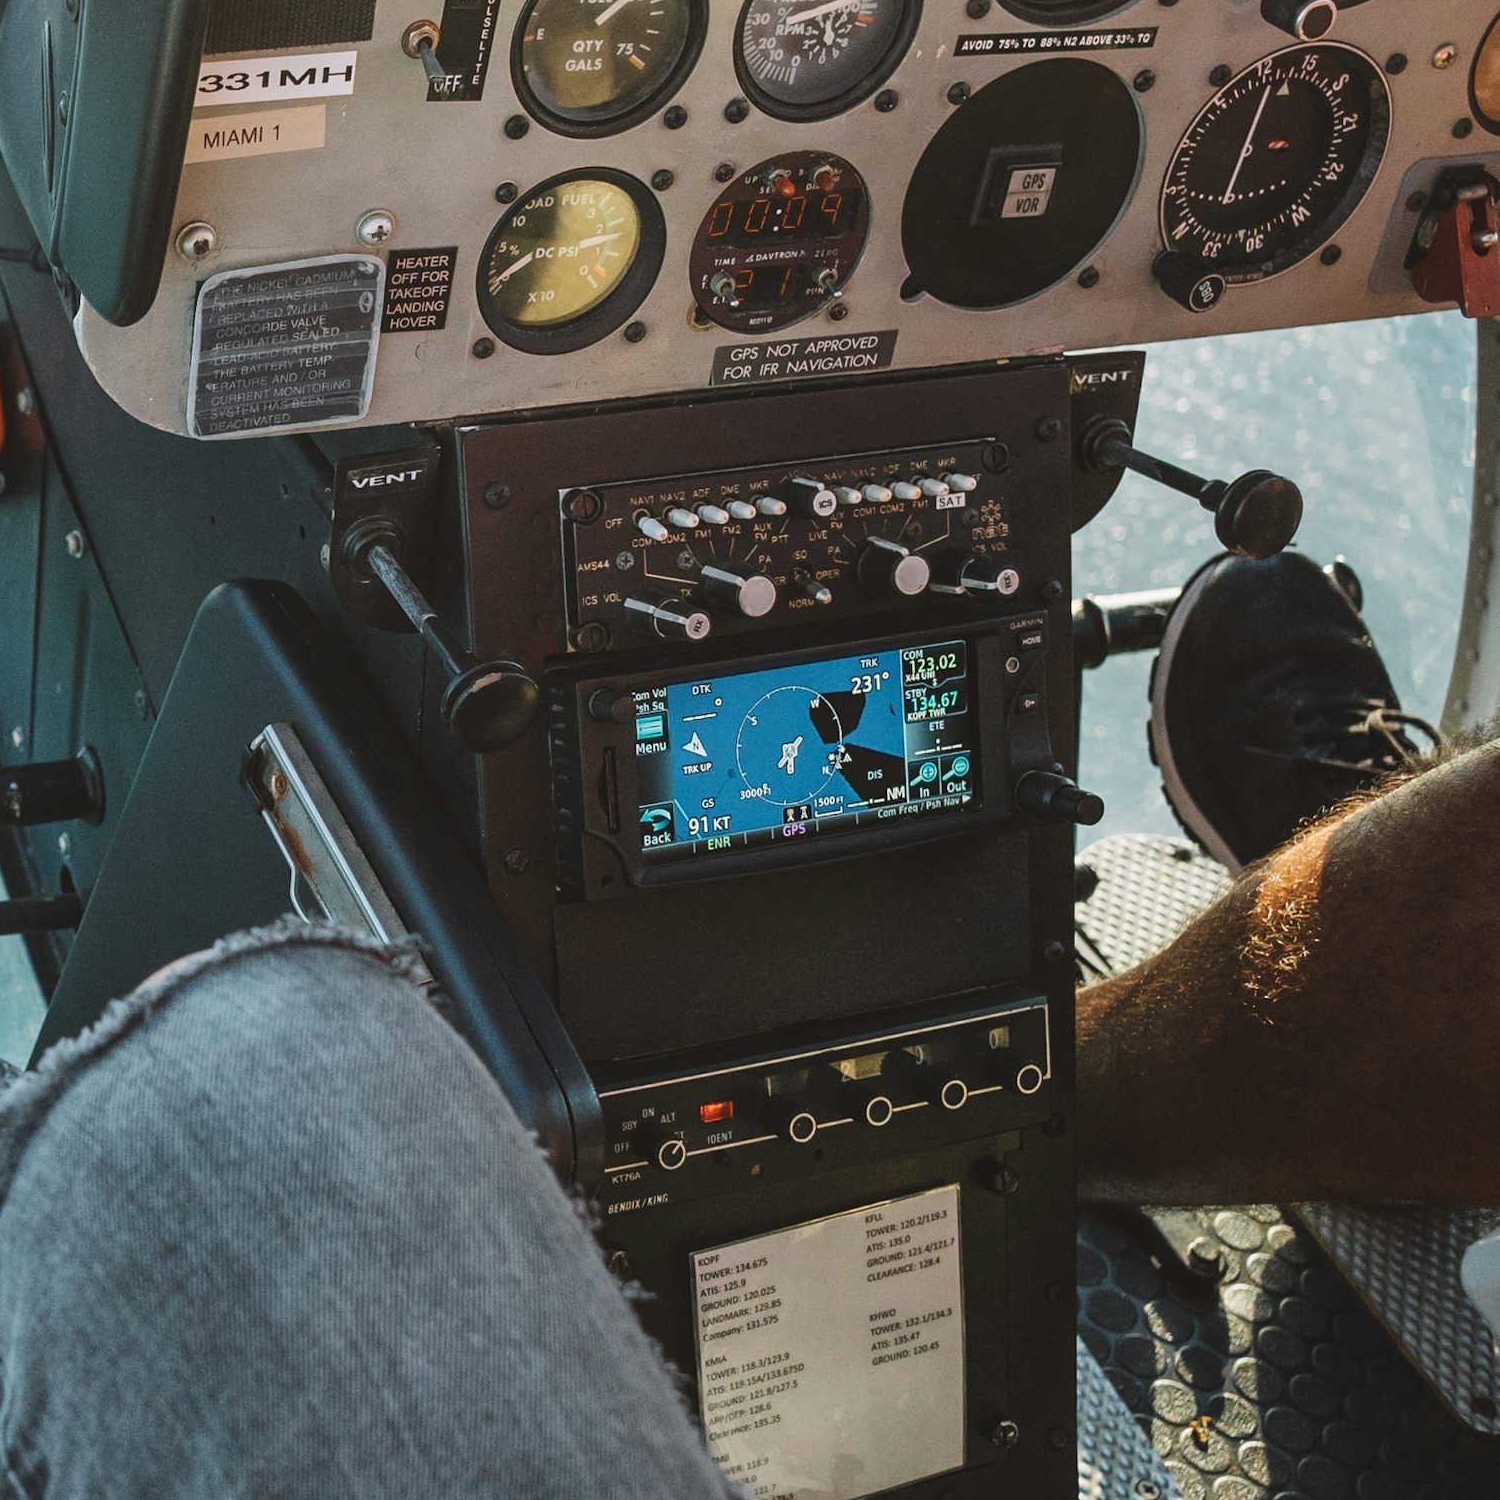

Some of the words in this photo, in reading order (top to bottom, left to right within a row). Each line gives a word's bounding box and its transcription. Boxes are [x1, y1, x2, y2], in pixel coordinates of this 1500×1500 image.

[573, 41, 603, 52] QTY
[617, 43, 633, 55] 75
[962, 40, 993, 50] AVOID
[999, 39, 1019, 49] 75%
[1023, 38, 1035, 47] TO
[1064, 37, 1077, 46] N2
[1079, 35, 1113, 45] ABOVE
[1114, 35, 1134, 44] 33%
[565, 59, 602, 71] GALS
[199, 66, 352, 92] 331MH
[204, 126, 263, 149] MIAMI
[273, 125, 279, 140] 1
[1022, 173, 1046, 190] GPS
[562, 194, 596, 206] FUEL
[1015, 197, 1039, 213] VOR
[536, 247, 553, 258] DC
[558, 247, 579, 257] PSI
[715, 258, 736, 266] TIME
[756, 251, 797, 261] DAVTRON
[396, 256, 448, 269] HEATER
[392, 273, 418, 284] OFF
[422, 271, 449, 282] FOR
[389, 286, 448, 299] TAKEOFF
[1199, 281, 1214, 302] OBS
[386, 301, 444, 314] LANDING
[290, 315, 327, 328] VALVE
[390, 316, 436, 329] HOVER
[730, 347, 758, 362] GPS
[767, 343, 799, 357] NOT
[805, 337, 879, 354] APPROVED
[723, 364, 751, 380] FOR
[760, 361, 779, 376] IFR
[786, 354, 878, 373] NAVIGATION
[1074, 371, 1131, 385] VENT
[352, 470, 422, 488] VENT
[819, 499, 833, 508] ICS
[939, 495, 962, 507] SAT
[603, 593, 621, 603] VOL
[904, 650, 923, 660] COM
[860, 658, 878, 668] TRK
[909, 654, 957, 673] 123.02
[851, 672, 889, 694] 231°
[692, 685, 711, 695] DTK
[905, 688, 927, 699] STBY
[911, 691, 958, 712] 134.67
[929, 708, 946, 717] TWR
[929, 722, 944, 731] ETE
[636, 742, 667, 755] Menu
[682, 764, 699, 775] TRK
[700, 762, 712, 772] UP
[868, 769, 883, 780] DIS
[887, 786, 905, 800] NM
[947, 780, 967, 793] Out
[702, 799, 715, 808] GS
[878, 808, 896, 819] Com
[899, 804, 918, 817] Freq
[926, 797, 941, 809] Psh
[944, 796, 959, 807] Nav
[688, 817, 708, 835] 91
[713, 816, 730, 831] KT
[783, 824, 806, 836] GPS
[644, 832, 671, 846] Back
[708, 837, 731, 850] ENR
[642, 1108, 655, 1118] ON
[661, 1113, 676, 1124] ALT
[622, 1121, 637, 1131] SBY
[707, 1131, 733, 1144] IDENT
[865, 1213, 883, 1224] KFLL
[866, 1223, 898, 1238] TOWER:
[889, 1235, 910, 1248] 135.0
[698, 1255, 719, 1267] KOPF
[867, 1251, 906, 1268] GROUND:
[700, 1268, 733, 1282] TOWER:
[736, 1258, 768, 1273] 134.675
[867, 1263, 916, 1282] CLEARANCE:
[919, 1257, 940, 1269] 128.4
[724, 1279, 746, 1292] 125.9
[755, 1299, 781, 1313] 129.85
[869, 1309, 896, 1322] KHWO
